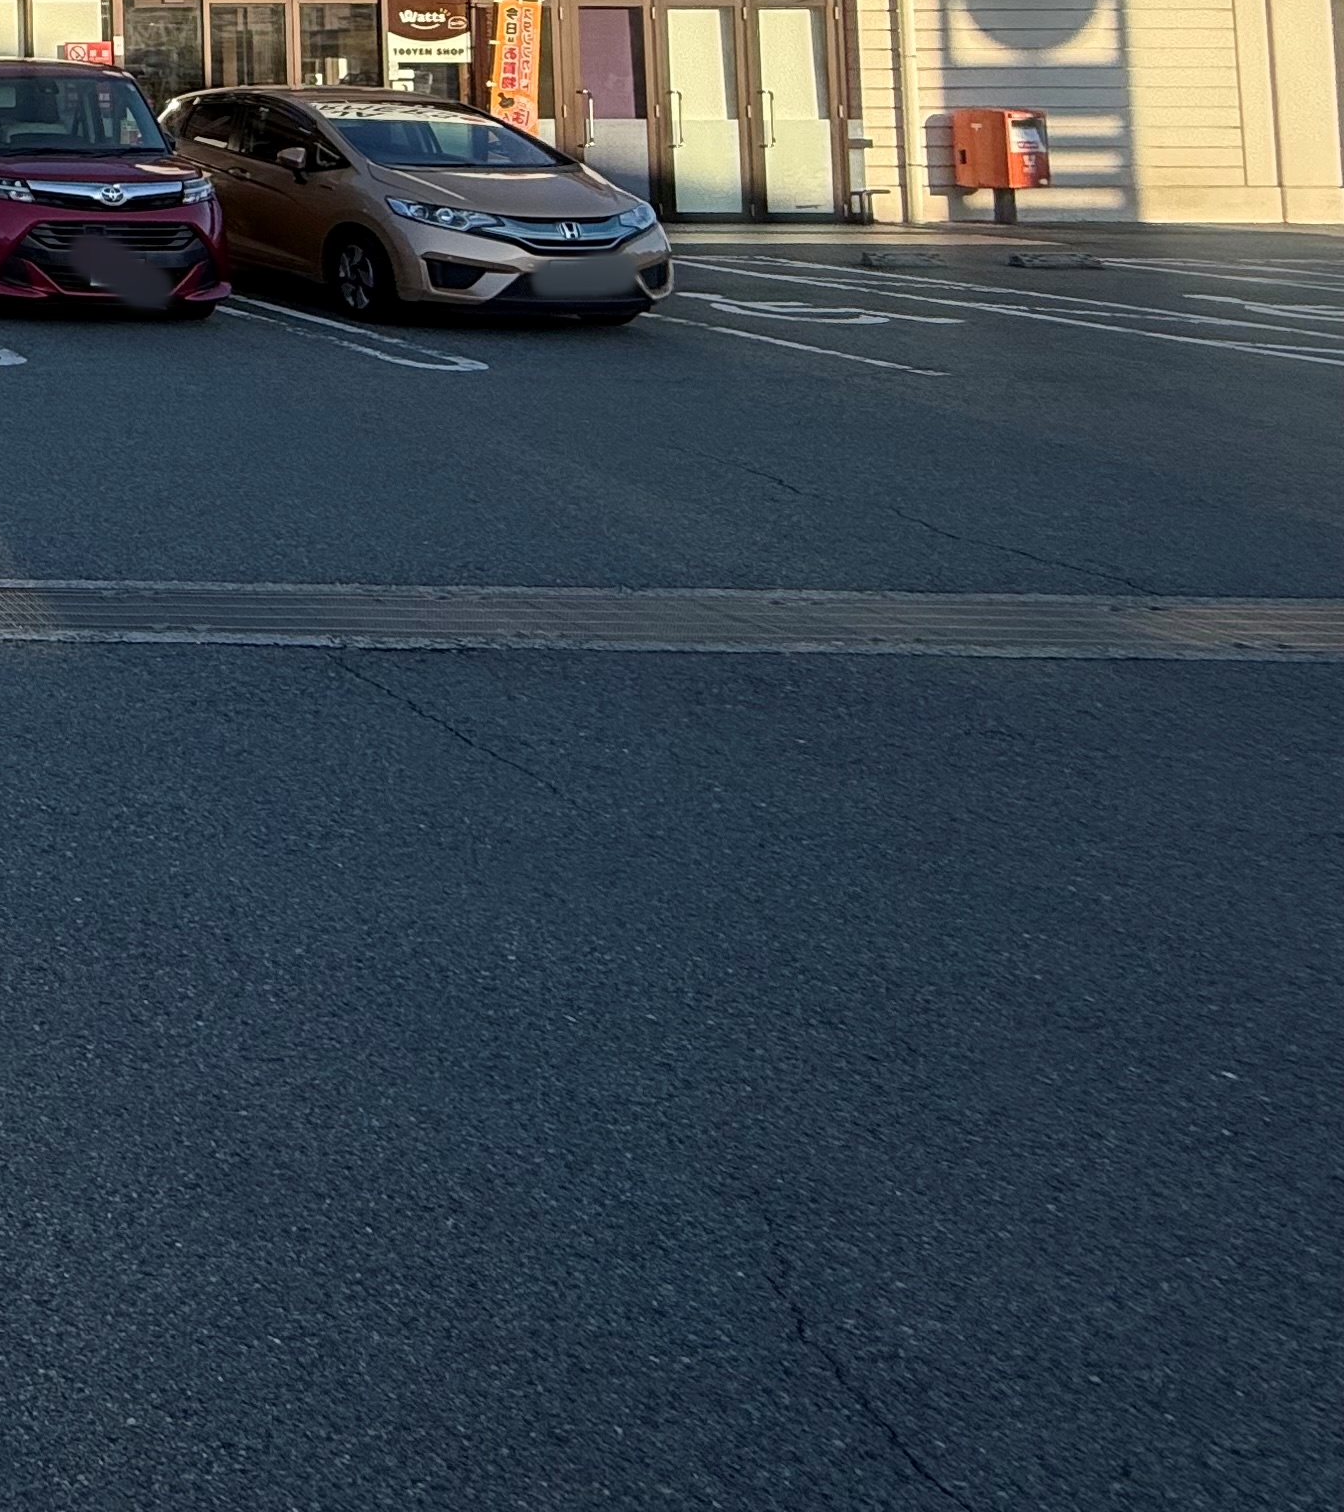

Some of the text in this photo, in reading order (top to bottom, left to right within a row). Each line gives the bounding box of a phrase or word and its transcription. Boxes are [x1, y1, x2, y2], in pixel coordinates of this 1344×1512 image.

[398, 9, 447, 23] Watts
[393, 48, 465, 56] 100YEN SHOP
